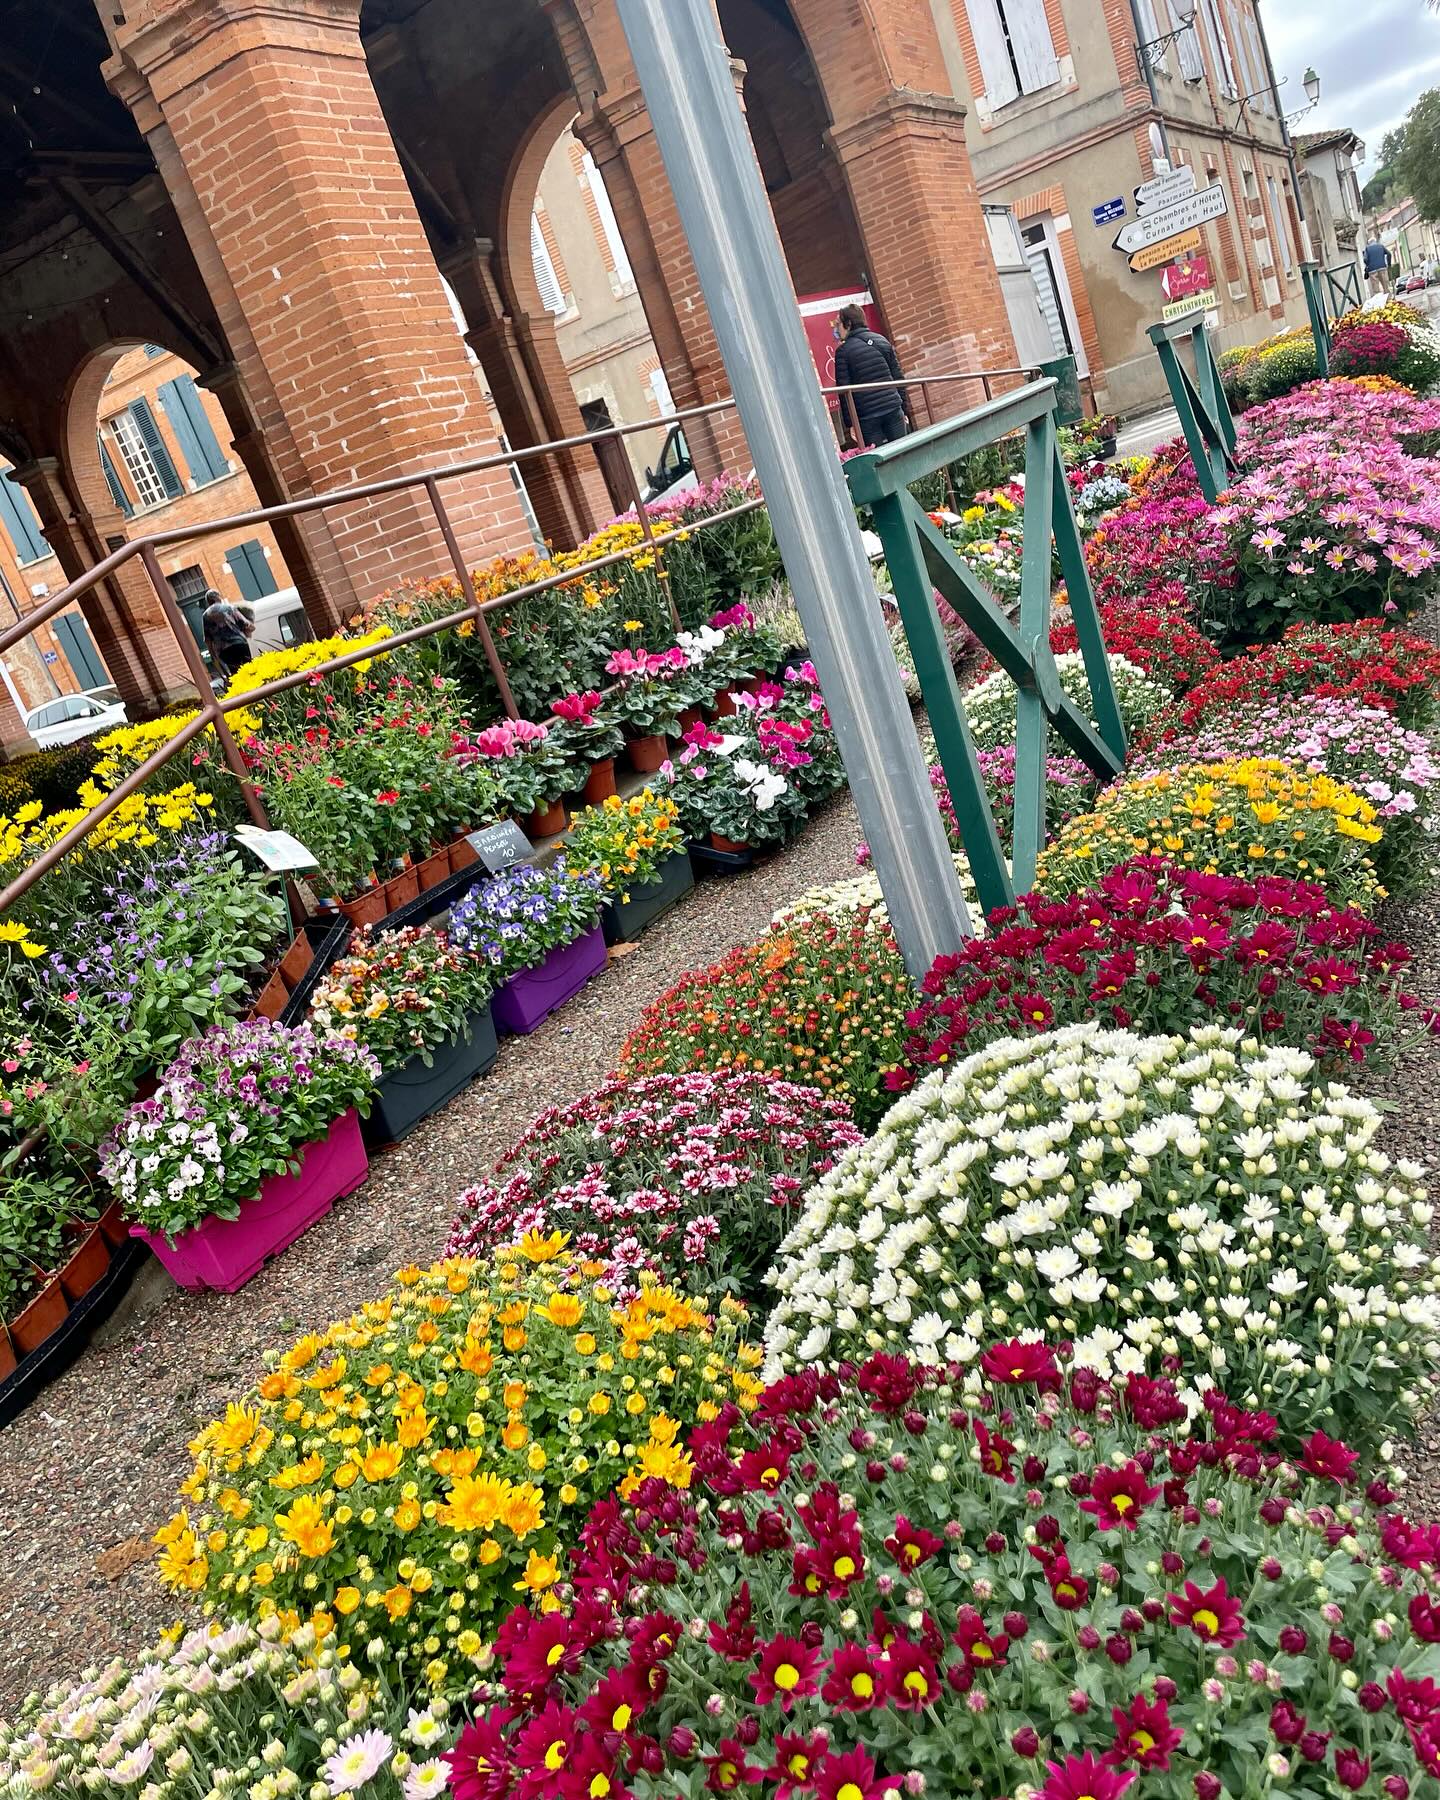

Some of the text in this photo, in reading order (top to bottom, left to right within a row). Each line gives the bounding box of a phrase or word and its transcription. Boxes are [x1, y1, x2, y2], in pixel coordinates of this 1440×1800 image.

[1141, 172, 1182, 193] Marché Fermier
[1153, 191, 1221, 226] Chambres d'Hôtes
[1158, 187, 1192, 207] Pharmacie
[1145, 223, 1175, 240] Curnat
[1180, 213, 1198, 226] d'en
[1203, 201, 1223, 216] Haut
[1138, 238, 1182, 261] pension canine
[1149, 253, 1166, 264] Plaine
[1164, 295, 1214, 318] CHRYSANTHEMES
